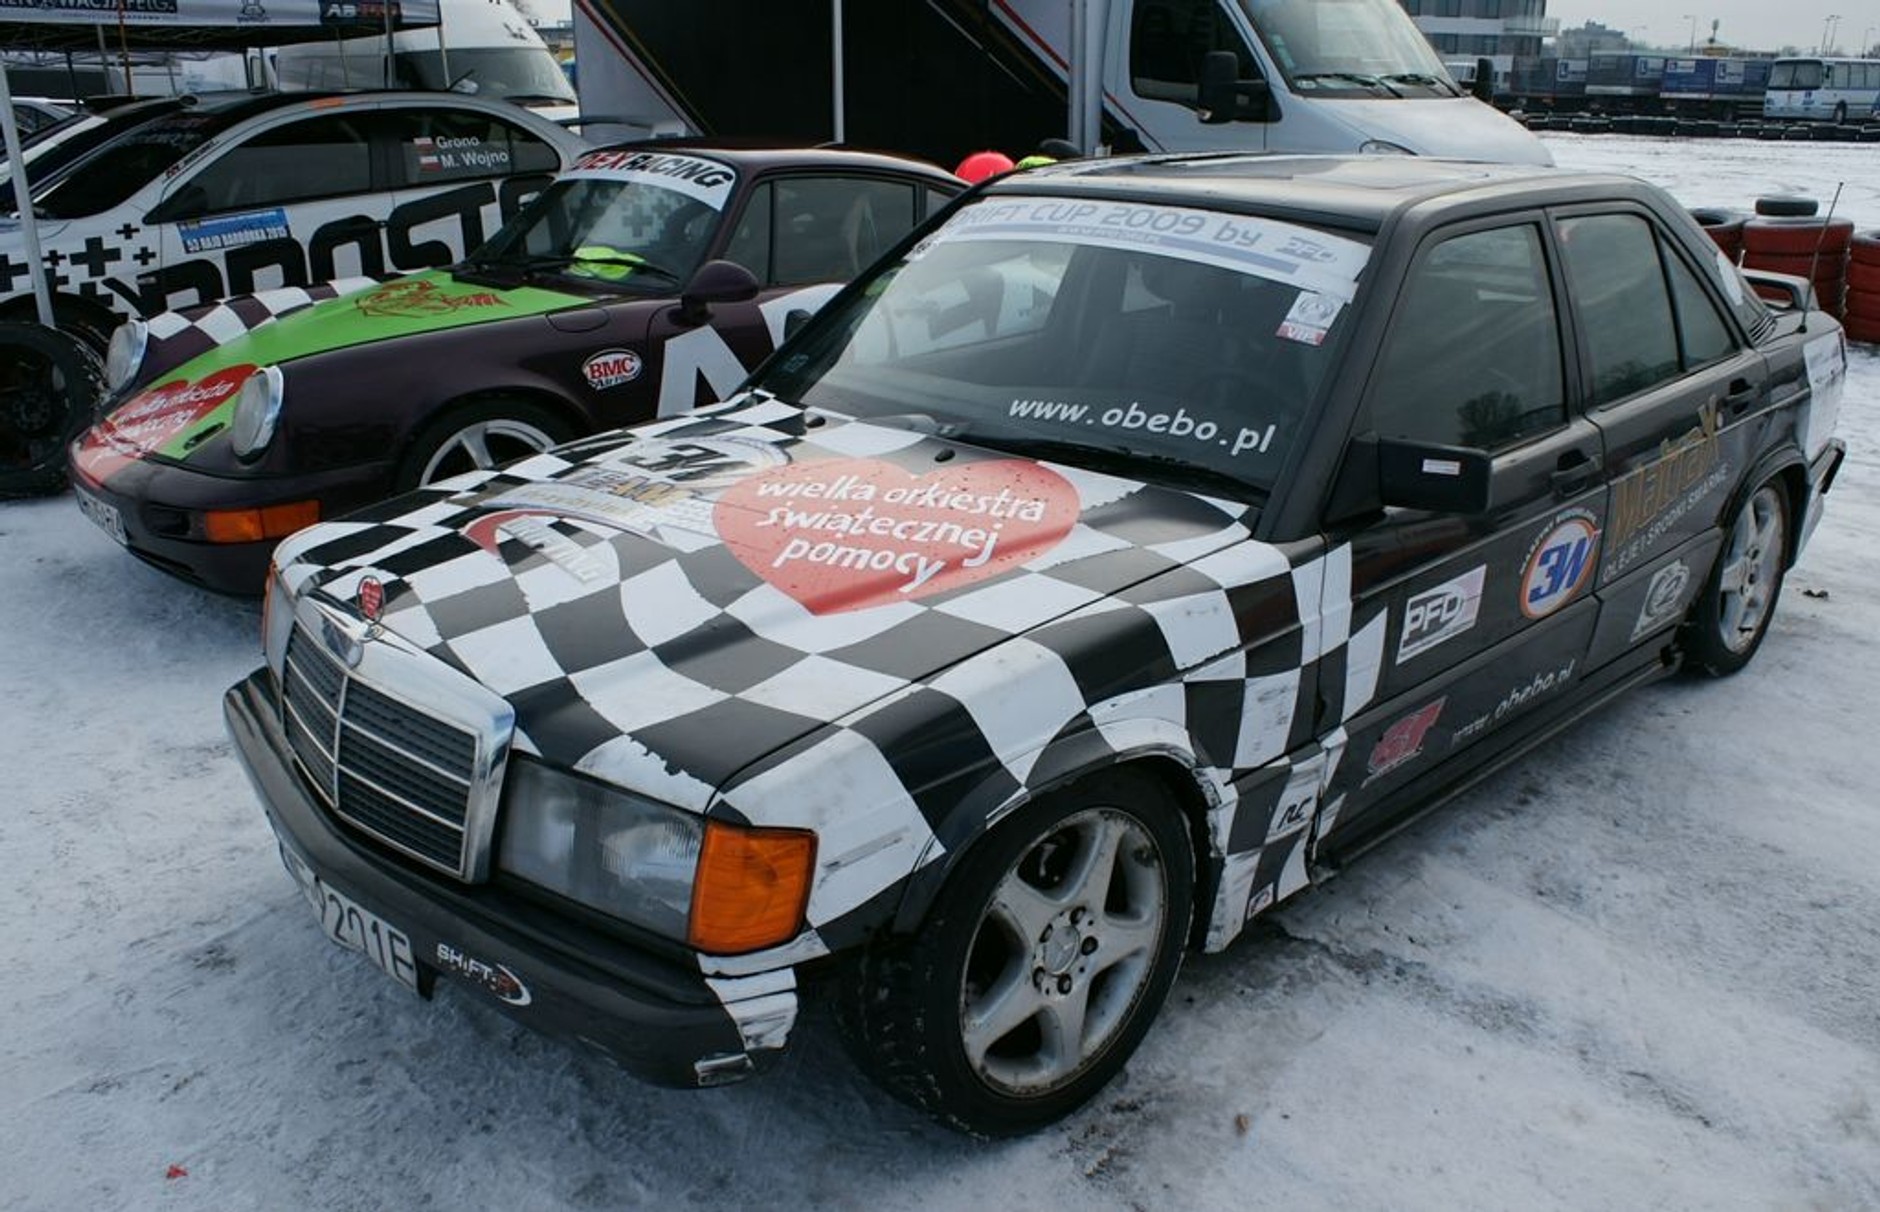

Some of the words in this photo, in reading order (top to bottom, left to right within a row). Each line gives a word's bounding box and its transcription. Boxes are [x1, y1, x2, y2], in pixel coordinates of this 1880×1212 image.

[435, 135, 480, 149] Grono
[441, 154, 460, 168] M.
[461, 150, 509, 168] Wojno
[1030, 203, 1098, 223] CUP
[1100, 206, 1206, 236] 2009
[1213, 220, 1263, 247] by
[589, 356, 635, 380] BMC
[1008, 398, 1276, 457] www.obebo.pl
[757, 475, 877, 501] wielka
[883, 482, 1046, 523] orkiestra
[755, 501, 1004, 568] świątecznej
[771, 538, 946, 593] pomocy
